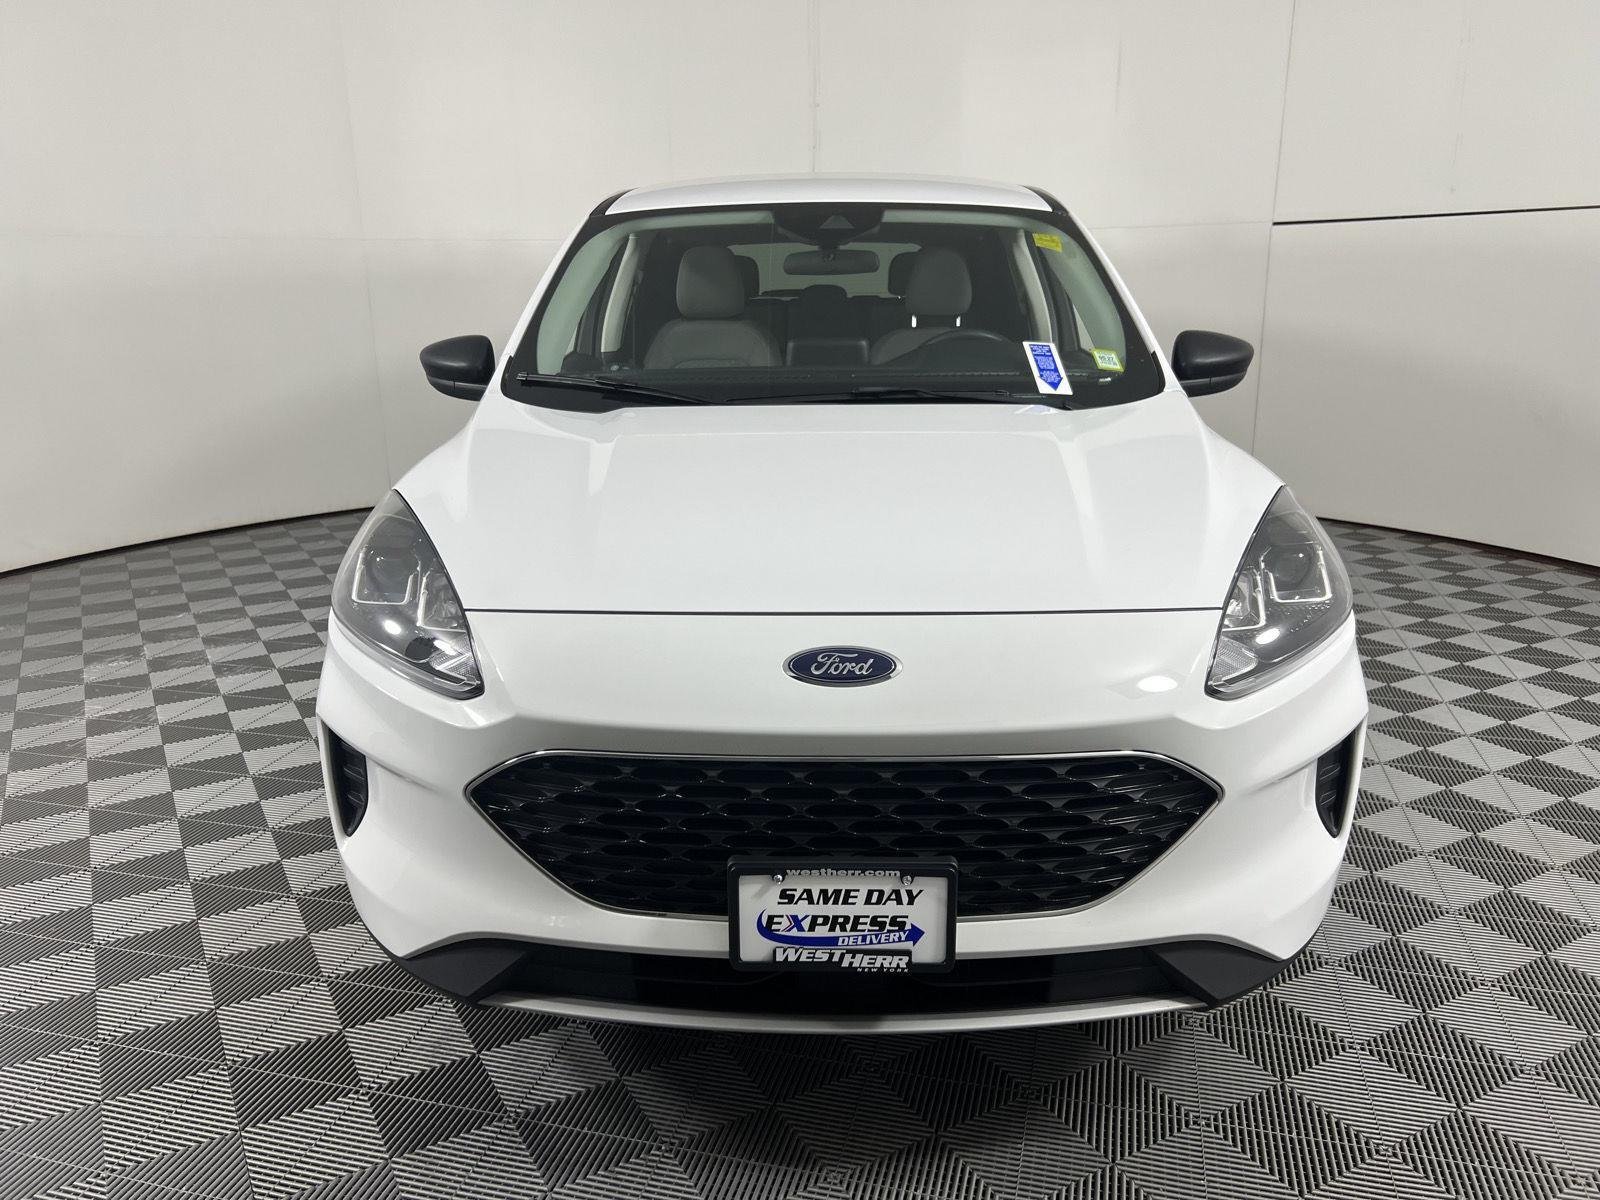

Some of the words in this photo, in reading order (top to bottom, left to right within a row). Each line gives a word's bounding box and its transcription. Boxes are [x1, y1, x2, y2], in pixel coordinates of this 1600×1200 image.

[810, 652, 874, 675] Ford
[786, 868, 900, 878] westherr.com
[777, 888, 859, 905] SAME
[864, 888, 924, 905] DAY
[765, 914, 909, 932] EXPRESS
[838, 931, 909, 946] DELIVERY
